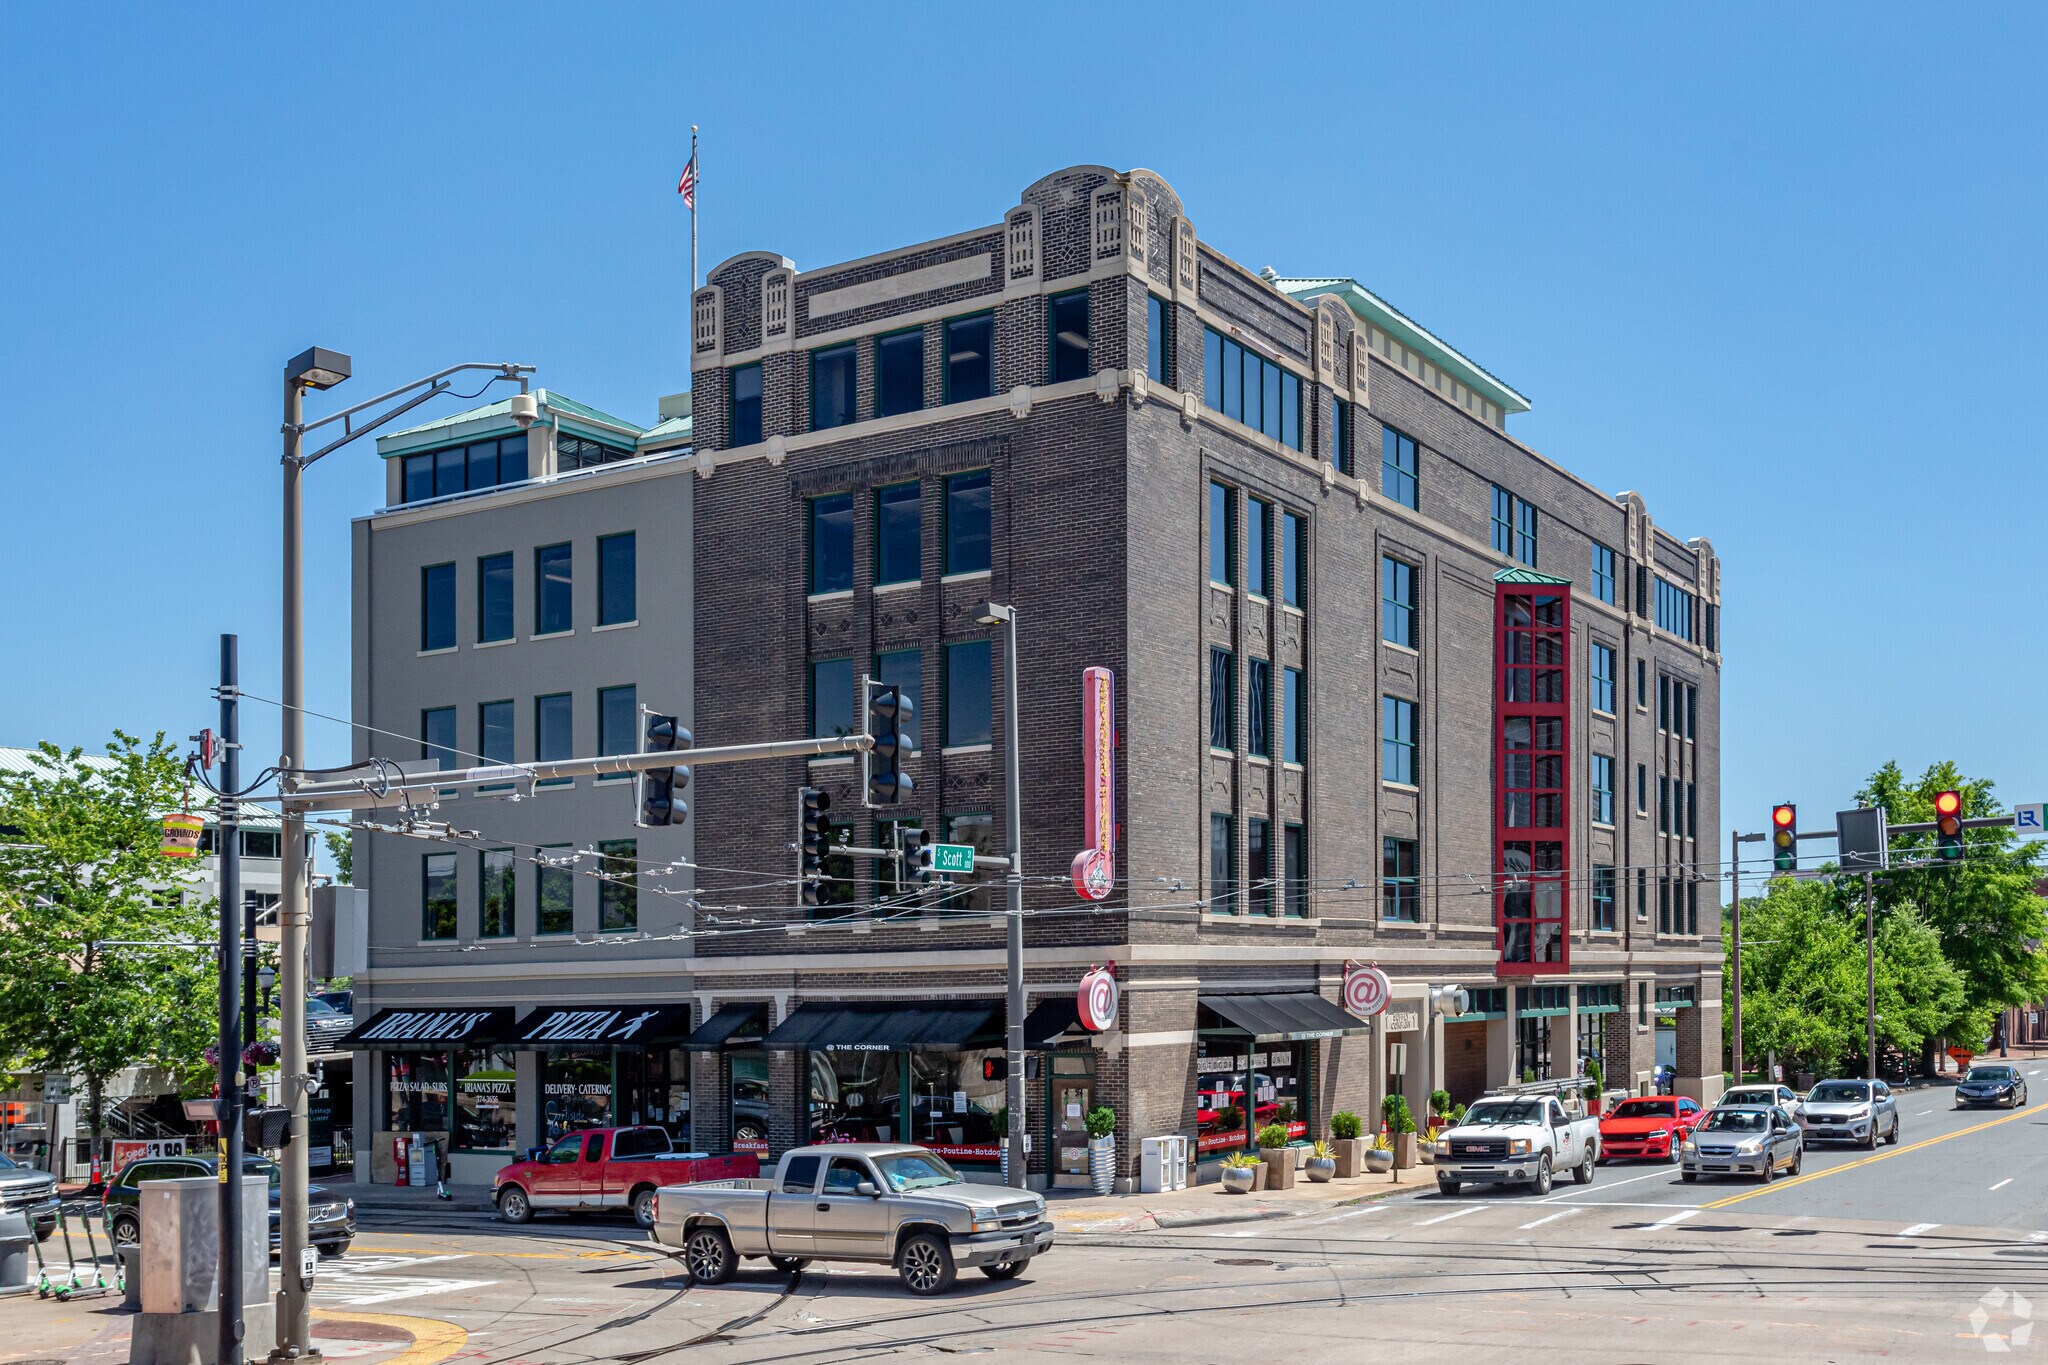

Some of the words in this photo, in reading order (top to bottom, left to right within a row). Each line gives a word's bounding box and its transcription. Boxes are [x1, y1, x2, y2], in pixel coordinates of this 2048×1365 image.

[164, 828, 199, 839] GROUNDS
[942, 850, 962, 866] Scott
[1346, 973, 1380, 1011] @
[359, 1012, 491, 1039] IRIANA'S
[522, 1010, 621, 1040] PIZZA
[1197, 1061, 1232, 1071] OUTDOOR
[1272, 1056, 1290, 1064] ONLY
[409, 1082, 429, 1091] SALAD
[432, 1082, 448, 1092] SUBS
[464, 1082, 491, 1093] IRIANA'S
[492, 1083, 511, 1093] PIZZA
[545, 1083, 575, 1095] DELIVERY
[578, 1084, 612, 1095] CATERING
[1208, 1136, 1226, 1146] Poutine
[1229, 1133, 1246, 1142] Hotdogs
